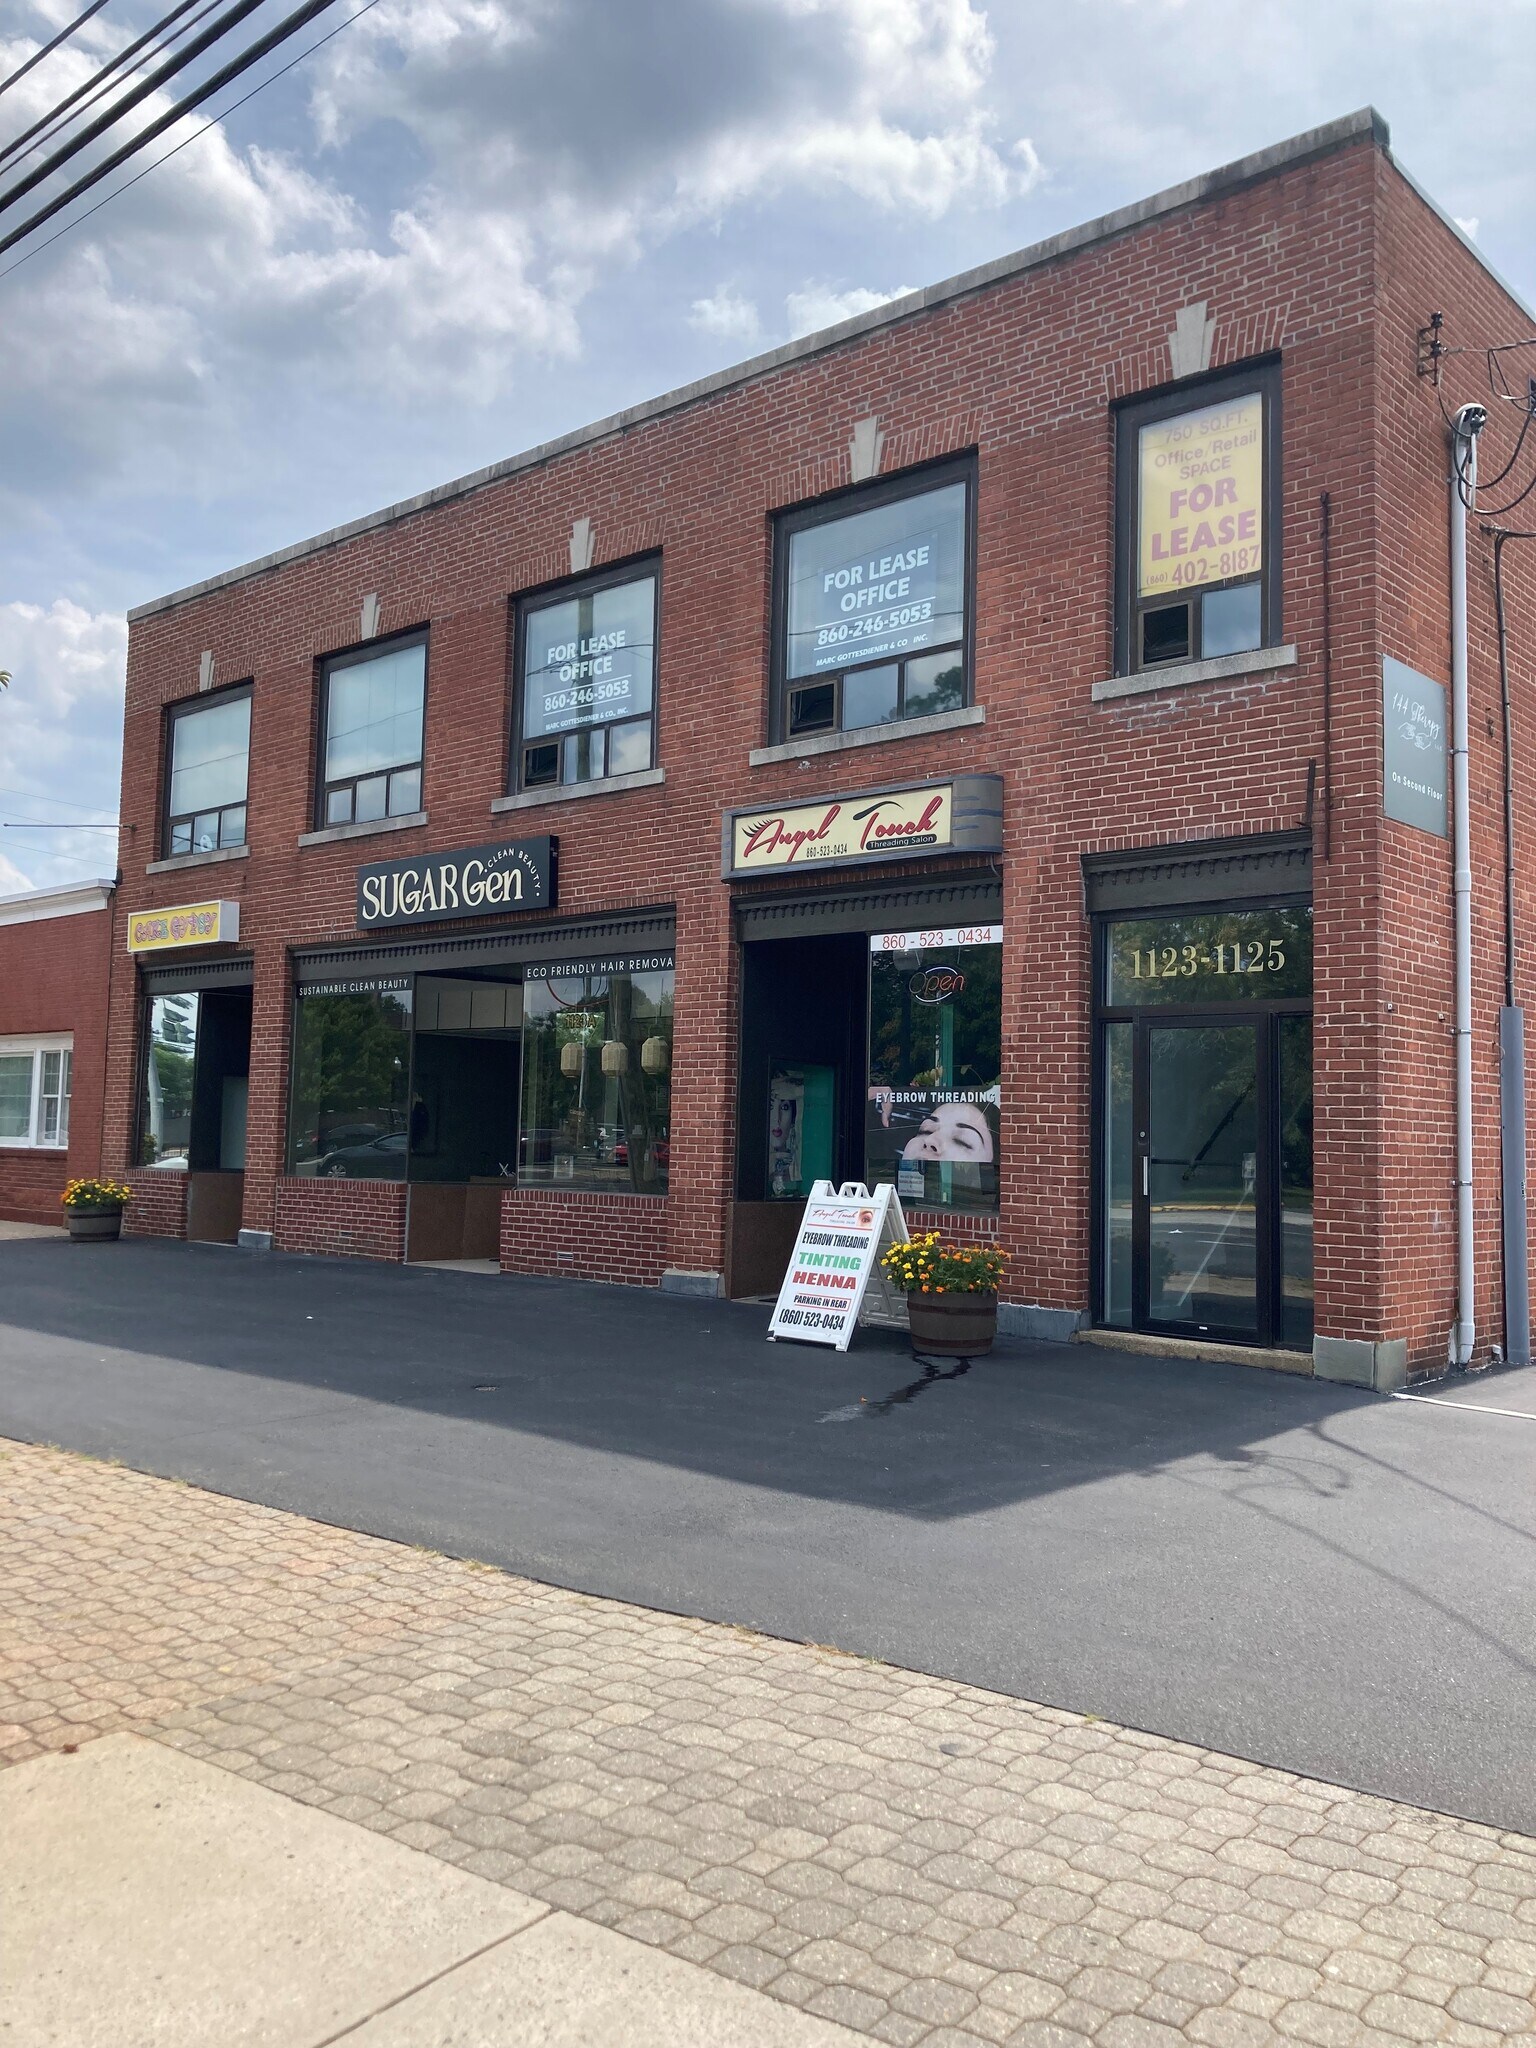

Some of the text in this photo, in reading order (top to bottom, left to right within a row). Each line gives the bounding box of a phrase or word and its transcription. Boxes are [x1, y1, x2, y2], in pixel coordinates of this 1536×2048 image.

[1165, 409, 1248, 444] 750 SQ.FT.
[1154, 429, 1257, 468] Office/Retail
[1180, 455, 1231, 480] SPACE
[1169, 477, 1238, 519] FOR
[1151, 509, 1256, 561] LEASE
[823, 545, 930, 592] FOR LEASE
[1146, 544, 1260, 586] (860) 402-8187
[840, 576, 910, 612] OFFICE
[817, 602, 932, 645] 860-246-5053
[547, 629, 626, 665] FOR LEASE
[816, 655, 836, 667] MARC
[837, 643, 888, 662] GOTTESDIENER
[889, 641, 895, 649] &
[913, 633, 928, 644] INC.
[559, 655, 612, 682] OFFICE
[544, 680, 630, 711] 860-246-5053
[545, 721, 560, 731] MARC
[1410, 701, 1442, 740] Therapy
[1392, 771, 1443, 801] On Second Floor
[743, 795, 943, 862] Angel Touch
[869, 834, 934, 849] Threading Salon
[806, 843, 848, 858] 860-523-0434
[487, 848, 542, 889] CLEAN BEAUTY
[362, 863, 460, 920] SUGAR
[882, 934, 906, 949] 860
[919, 931, 944, 947] 523
[957, 928, 992, 944] 0434
[527, 967, 547, 978] ECO
[551, 963, 597, 976] FRIENDLY
[600, 960, 625, 972] HAIR
[1130, 939, 1285, 979] 1123-1125
[299, 978, 409, 996] SUSTAINABLE CLEAN BEAUTY
[908, 971, 965, 999] Open
[875, 1091, 996, 1103] EYEBROW THREADING
[802, 1231, 870, 1250] EYEBROW THREADING
[799, 1252, 862, 1270] TINTING
[792, 1271, 857, 1290] HENNA
[793, 1294, 847, 1309] PARKING IN REAR
[778, 1308, 846, 1331] (860) 523-0434
